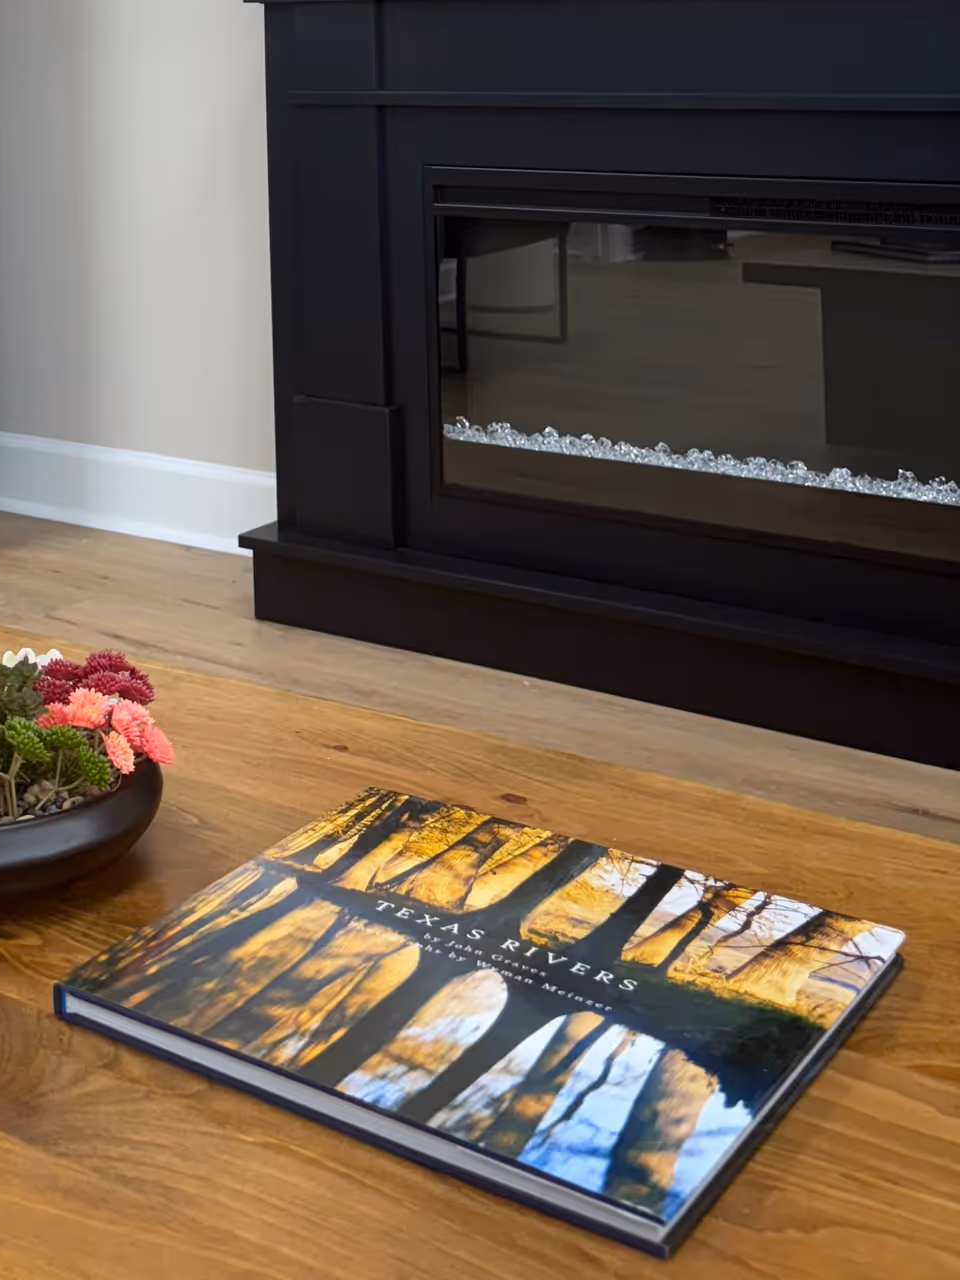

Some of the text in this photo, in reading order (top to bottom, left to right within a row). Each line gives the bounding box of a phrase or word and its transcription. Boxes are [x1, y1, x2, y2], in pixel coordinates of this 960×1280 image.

[374, 898, 487, 941] TEXAS
[499, 937, 641, 992] RIVERS
[423, 932, 441, 945] by
[447, 939, 483, 956] John
[490, 952, 548, 978] Graves
[448, 951, 615, 1012] by Wyman Meinzer
